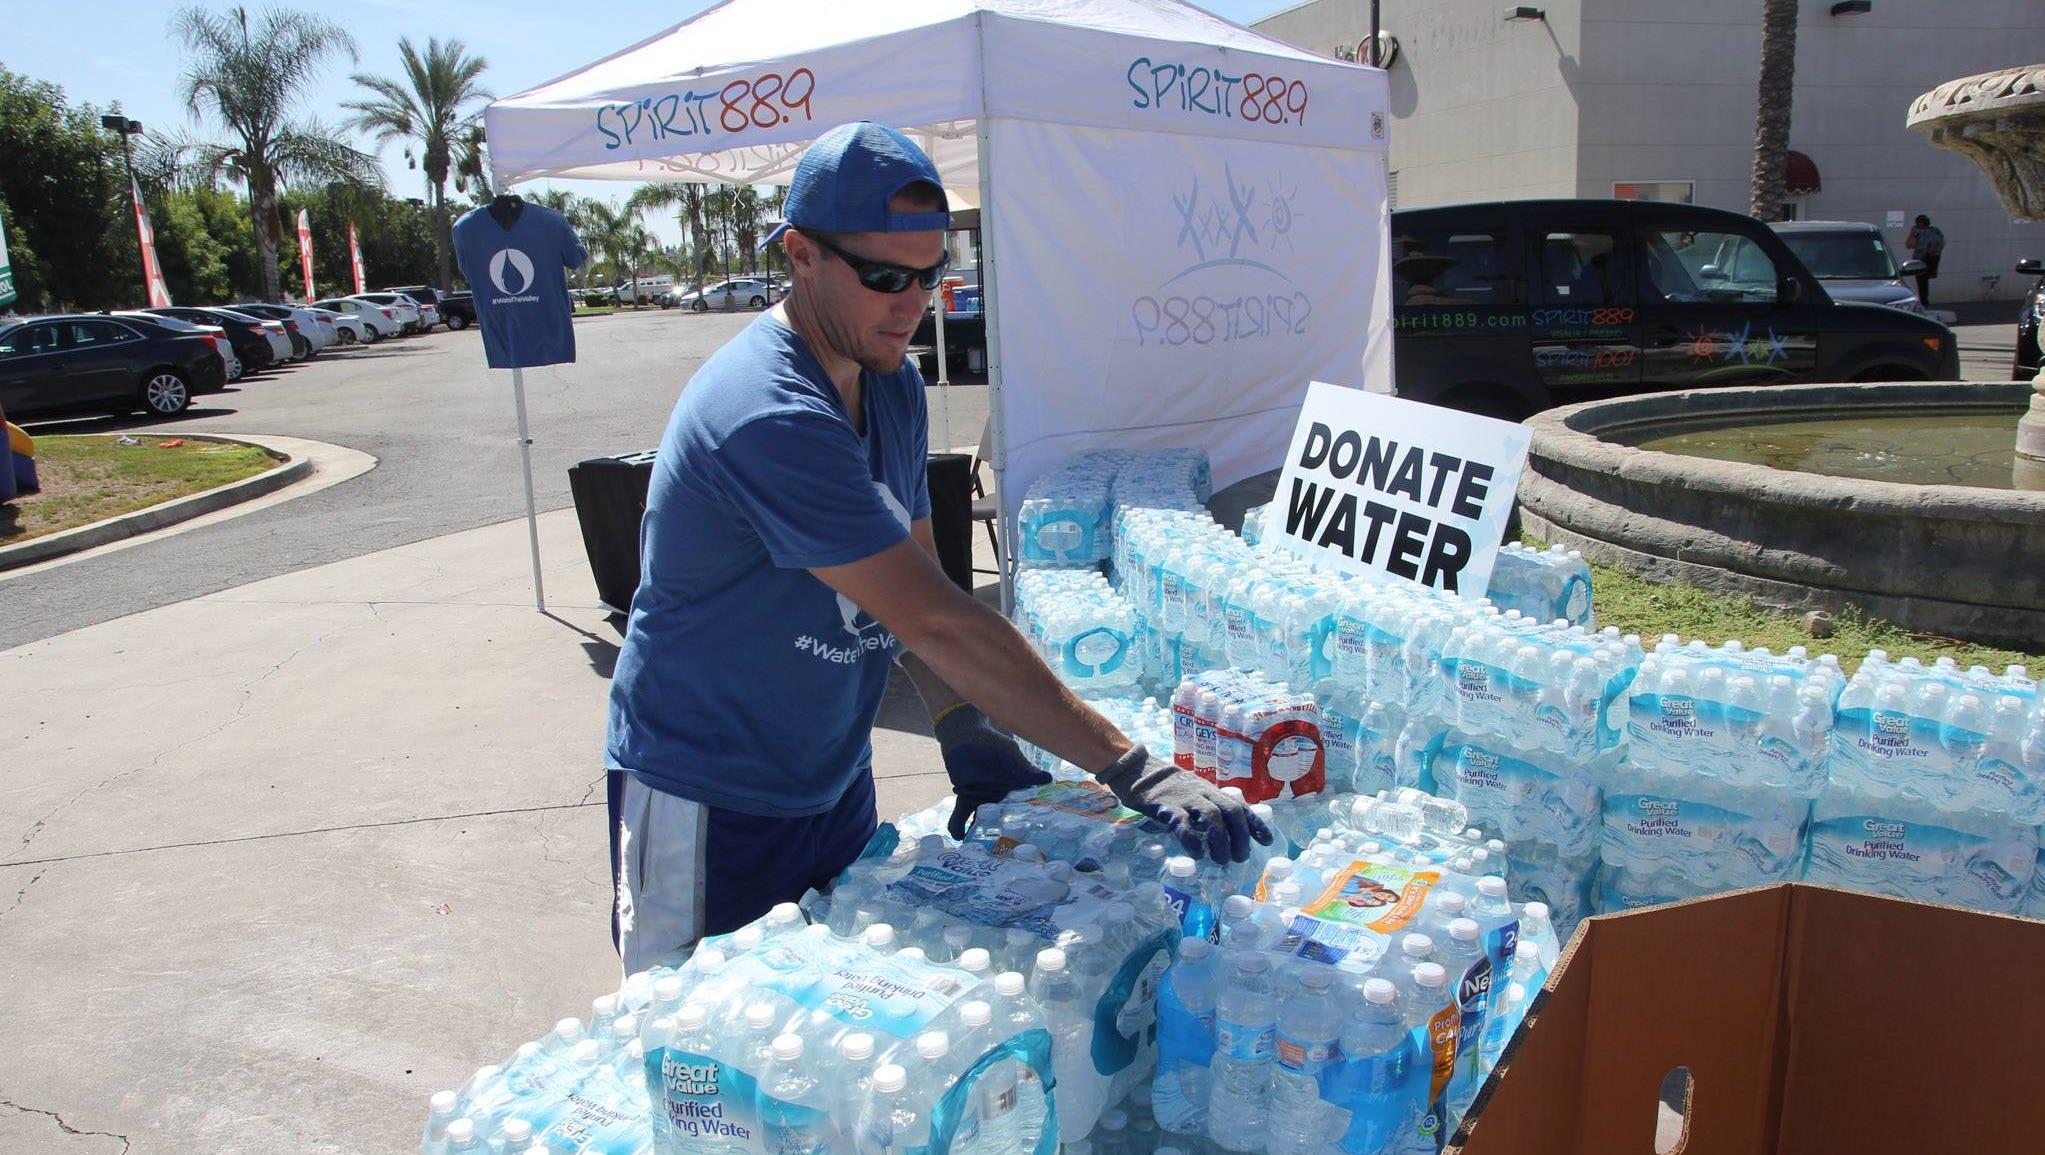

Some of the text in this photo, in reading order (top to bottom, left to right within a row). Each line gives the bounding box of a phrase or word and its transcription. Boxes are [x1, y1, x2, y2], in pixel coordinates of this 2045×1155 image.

[1299, 421, 1495, 521] DONATE
[1285, 476, 1472, 595] WATER
[1659, 696, 1695, 709] Great
[1665, 706, 1695, 717] Value
[1661, 716, 1697, 728] Purified
[1872, 711, 1911, 728] Great
[1650, 721, 1682, 738] Drinking
[1880, 723, 1911, 735] Value
[1872, 733, 1909, 747] Purified
[1464, 747, 1500, 764] Great
[1858, 738, 1928, 758] Drinking Water
[1471, 758, 1499, 770] Value
[1464, 768, 1499, 781] Purified
[1485, 779, 1508, 791] Water
[1638, 797, 1679, 811] Great
[1646, 807, 1679, 817] Value
[1627, 823, 1693, 838] Drinking Water
[1640, 818, 1679, 828] Purified
[1863, 818, 1905, 833] Great
[1872, 828, 1905, 839] Value
[1863, 840, 1904, 851] Purified
[1845, 845, 1921, 862] Drinking Water
[1504, 930, 1518, 949] 2
[839, 980, 895, 1001] Purified
[871, 974, 927, 1000] Drinking
[662, 1052, 720, 1084] Great
[667, 1075, 720, 1096] Value
[701, 1119, 750, 1141] Water
